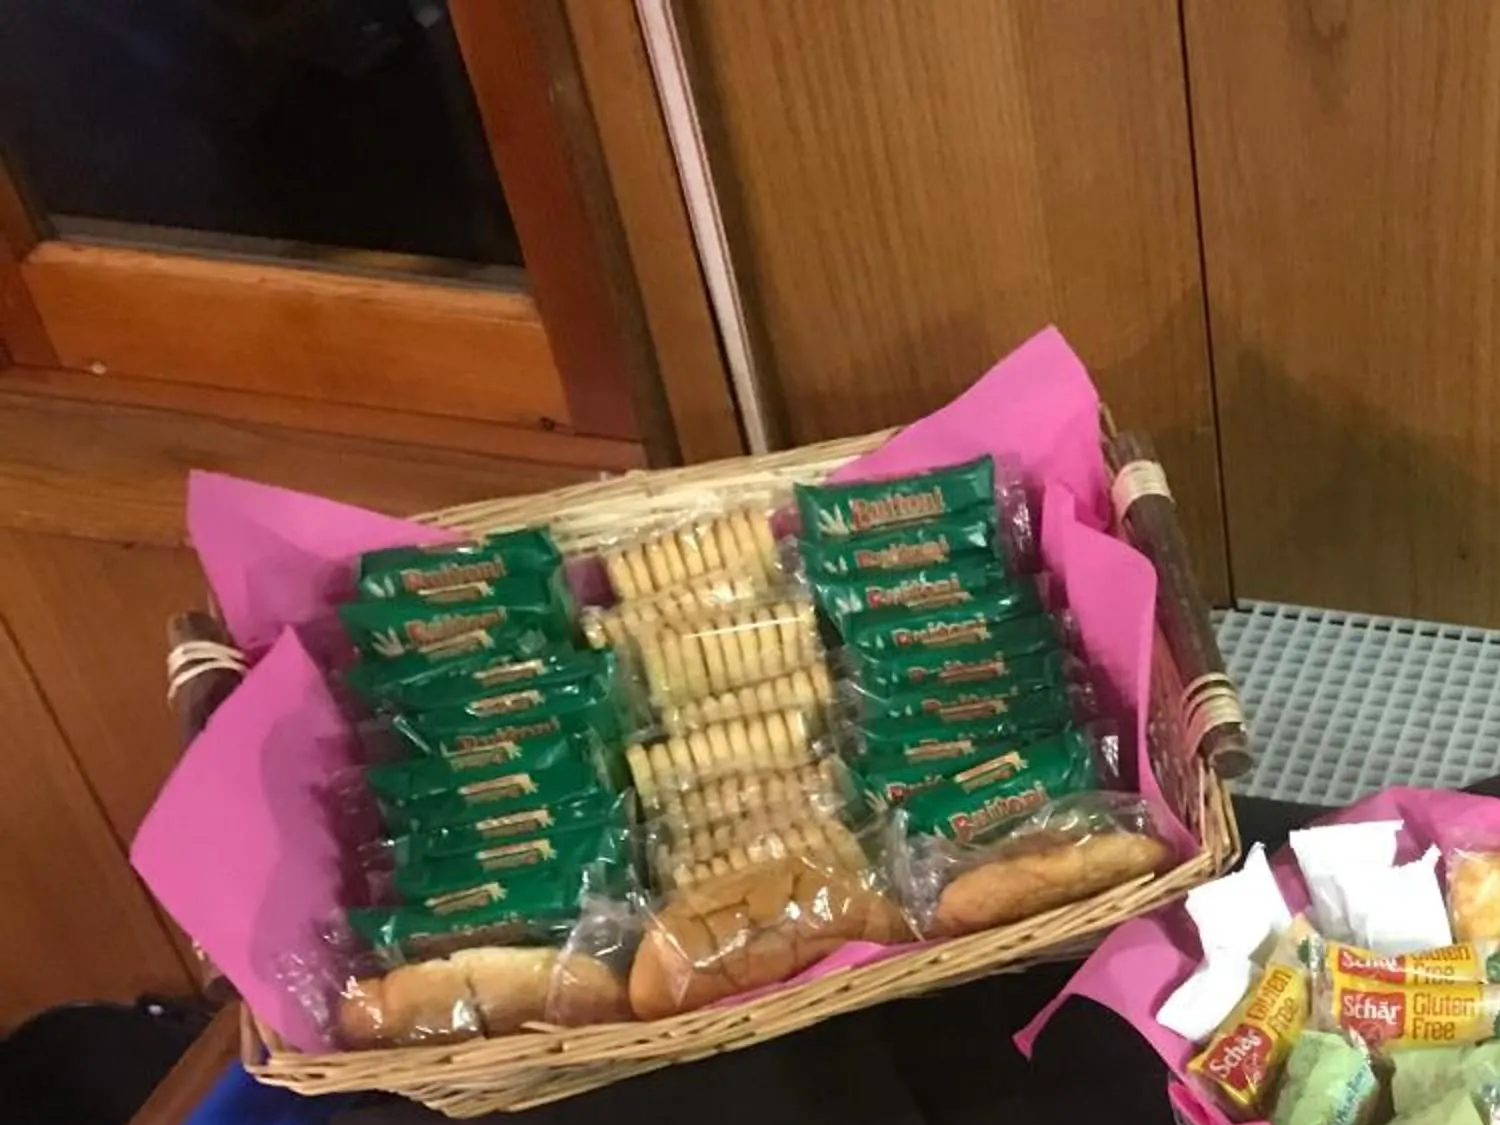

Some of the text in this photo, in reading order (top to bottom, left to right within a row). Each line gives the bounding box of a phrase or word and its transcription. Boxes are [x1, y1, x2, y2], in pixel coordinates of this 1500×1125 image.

[1246, 968, 1294, 1021] Gluten
[1412, 992, 1477, 1019] Gluten
[1267, 997, 1299, 1036] Free
[1412, 1017, 1456, 1041] Free
